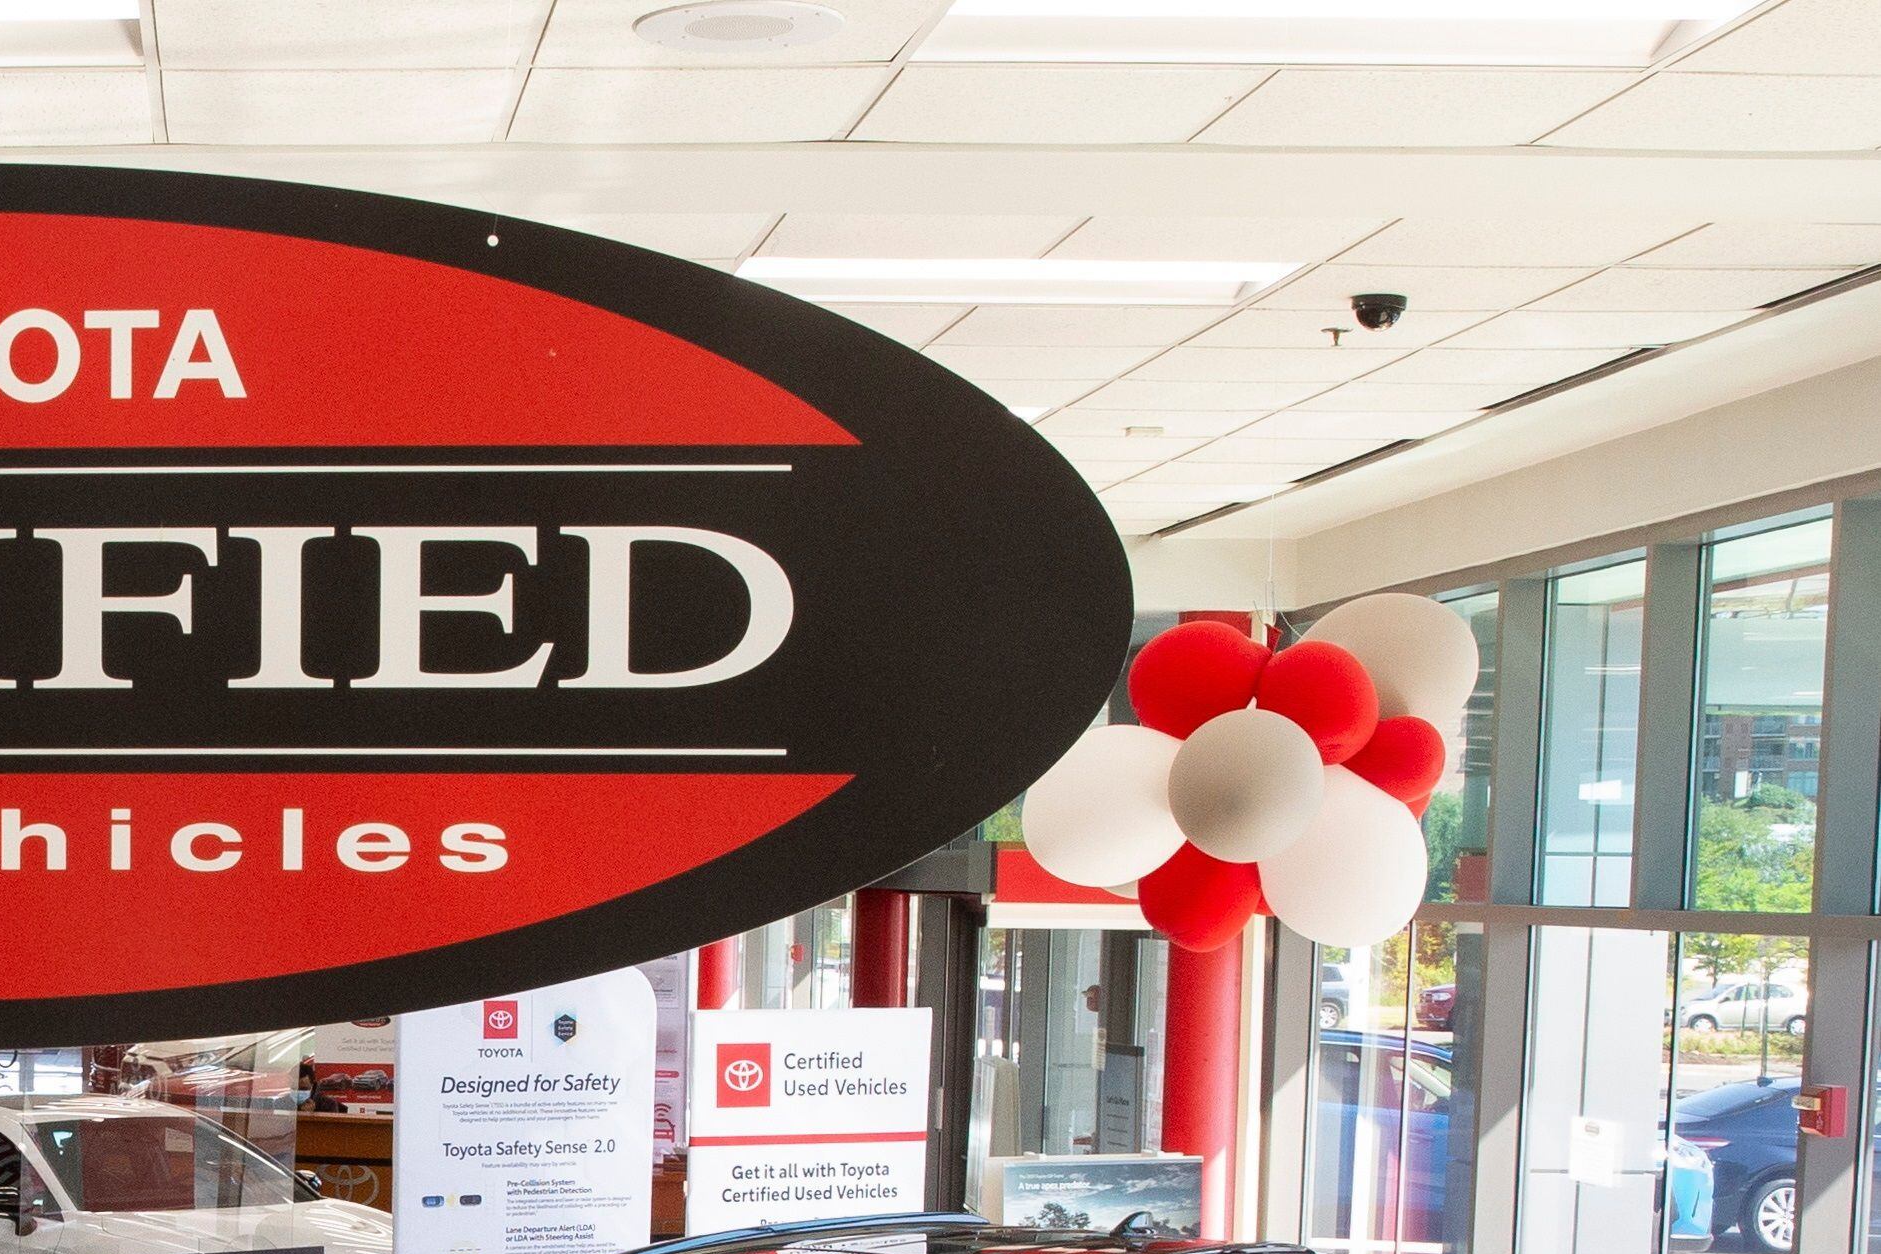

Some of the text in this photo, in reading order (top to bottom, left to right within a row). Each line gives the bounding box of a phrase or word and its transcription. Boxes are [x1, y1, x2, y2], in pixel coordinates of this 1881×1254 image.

[478, 1048, 524, 1058] TOYOTA
[784, 1052, 863, 1069] Certified
[441, 1073, 620, 1098] Designed for Safety
[784, 1078, 907, 1096] Used Vehicles
[442, 1139, 616, 1160] Toyota Safety Sense 2.0
[732, 1162, 890, 1180] Get it all with Toyota
[506, 1179, 576, 1187] Pre-Collision System
[506, 1186, 592, 1196] with Pedestrian Detection
[721, 1183, 898, 1203] Certified Used Vehicles
[514, 1234, 528, 1242] LDA
[529, 1234, 544, 1242] with
[545, 1233, 574, 1242] Steering
[523, 1226, 558, 1234] Departure
[576, 1224, 596, 1232] (LDA)
